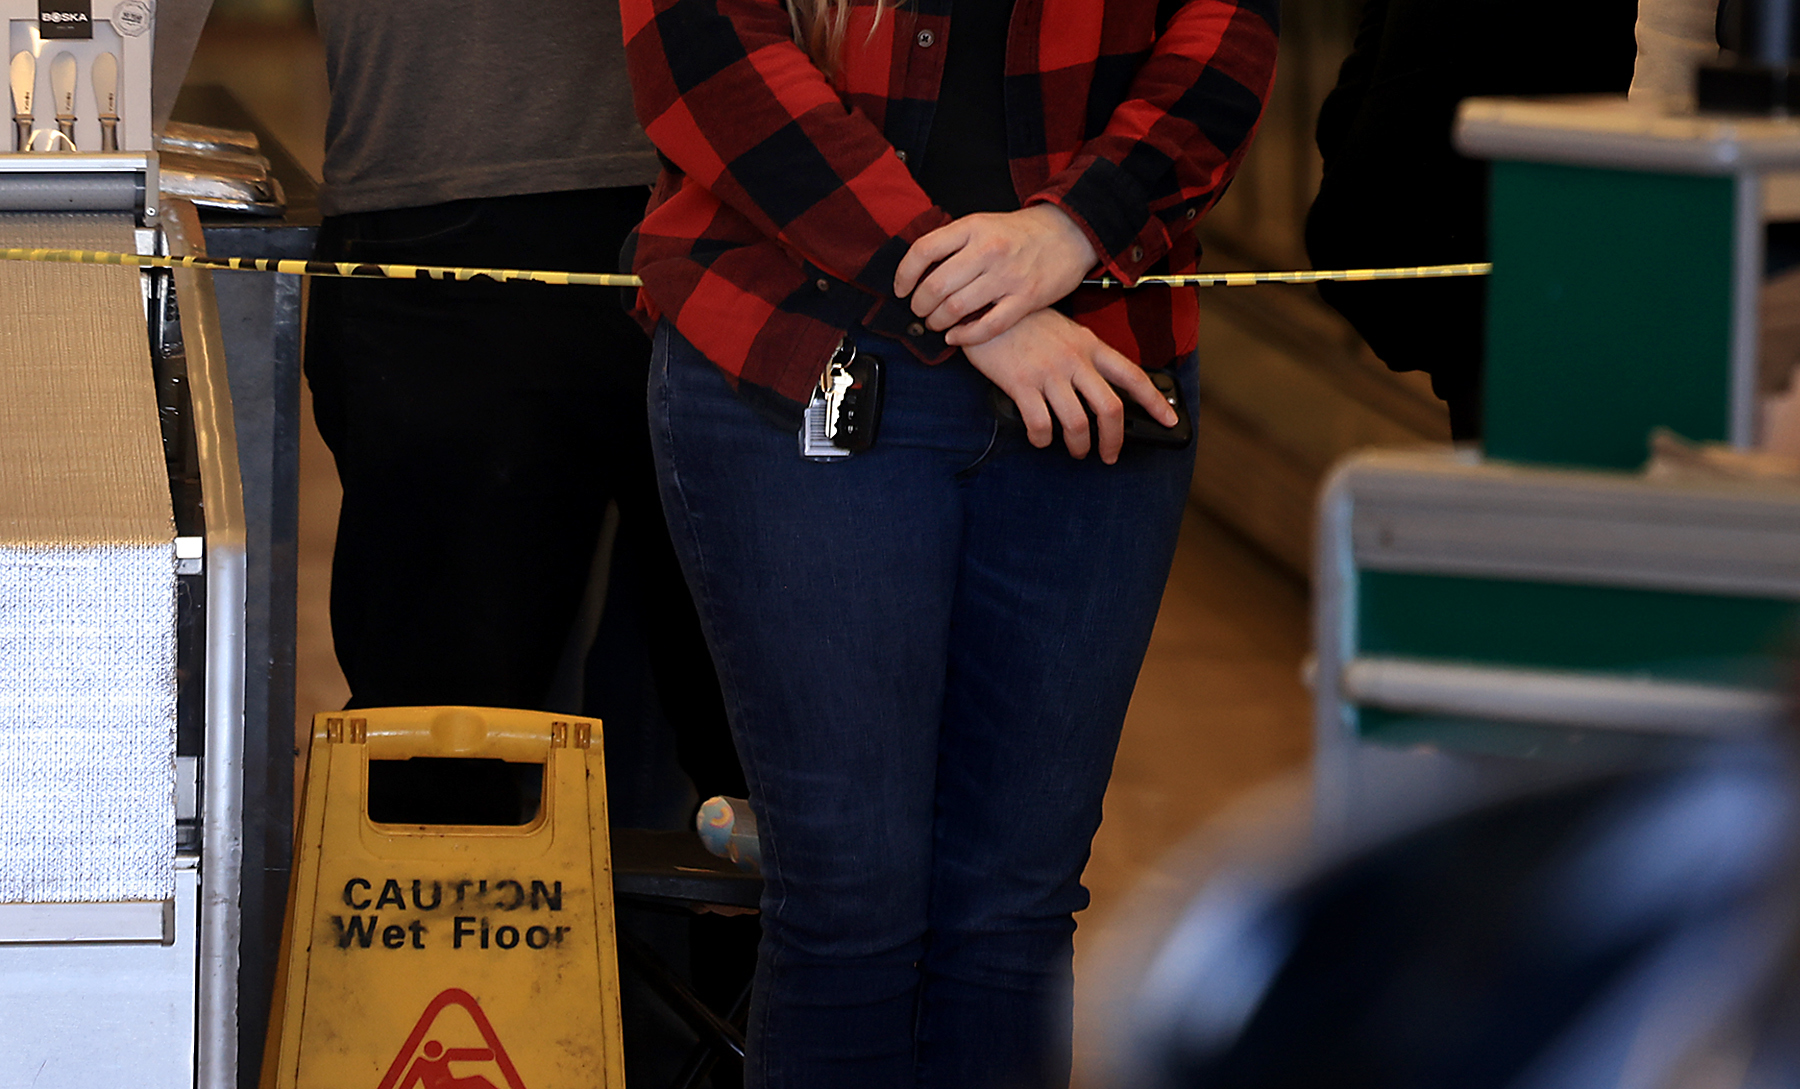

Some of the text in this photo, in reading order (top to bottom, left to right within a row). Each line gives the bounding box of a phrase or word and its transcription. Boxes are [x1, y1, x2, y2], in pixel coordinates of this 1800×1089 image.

[41, 11, 88, 23] BOSKA
[333, 915, 571, 950] Wet Floor
